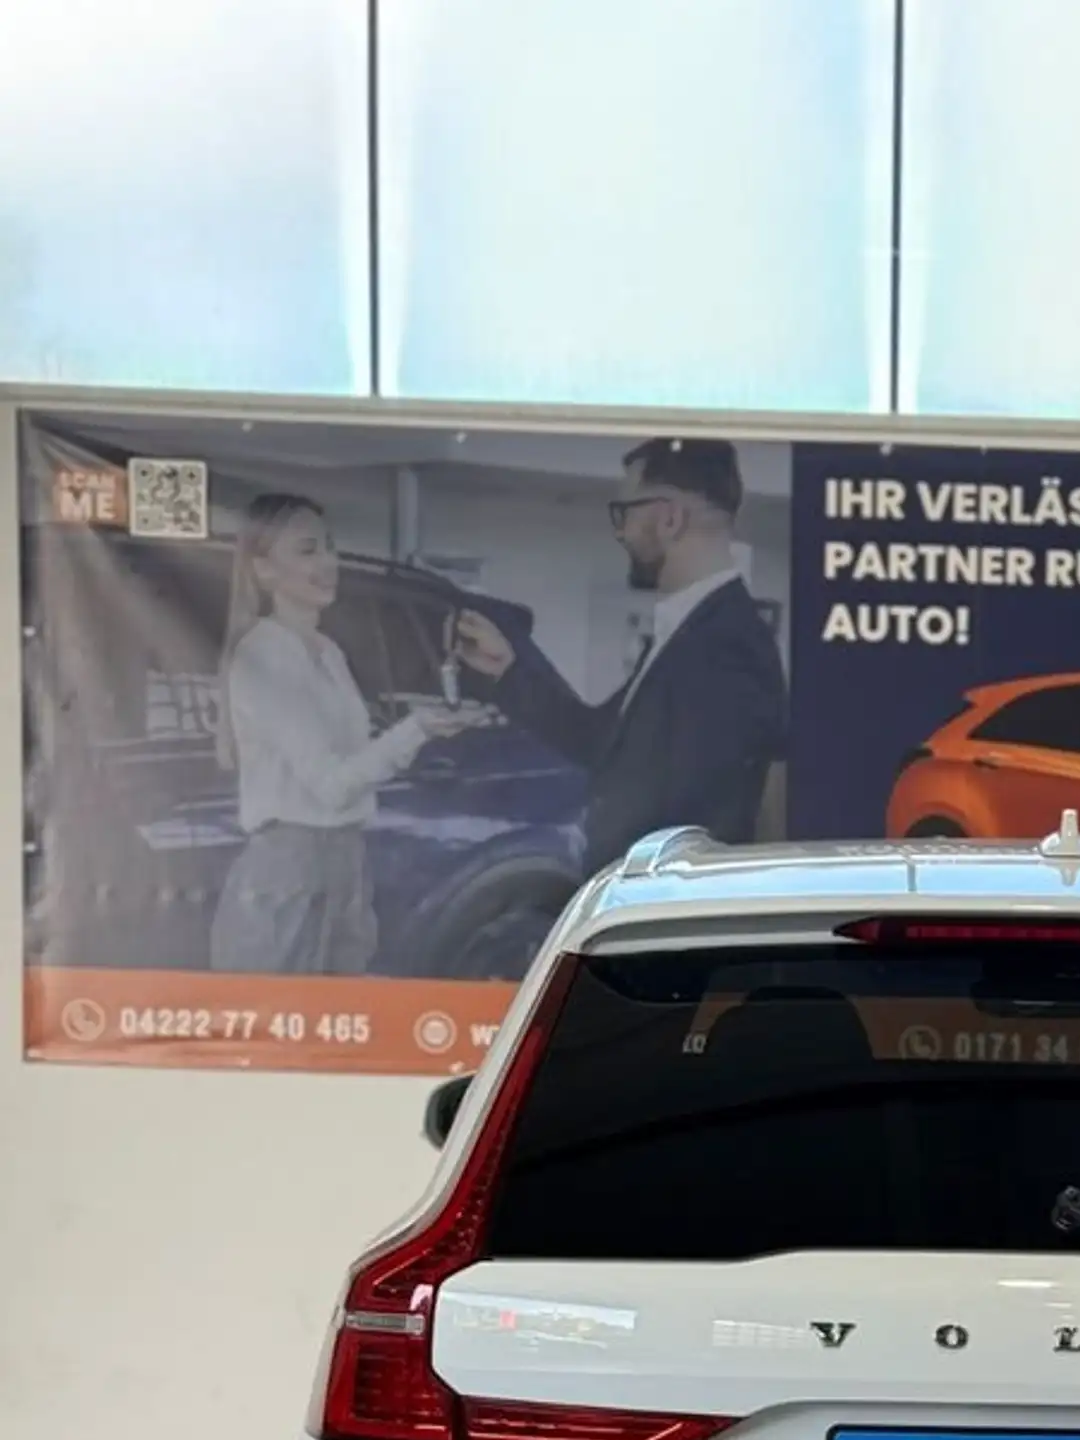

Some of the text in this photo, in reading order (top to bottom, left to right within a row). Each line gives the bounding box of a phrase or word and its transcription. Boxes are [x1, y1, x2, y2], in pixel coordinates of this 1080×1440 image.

[60, 490, 117, 523] ME
[825, 478, 904, 519] IHR
[823, 542, 1034, 586] PARTNER
[822, 603, 970, 645] AUTO!
[119, 1006, 371, 1044] 04222 77 40 465
[954, 1031, 1021, 1062] 0171
[1033, 1033, 1068, 1063] 34
